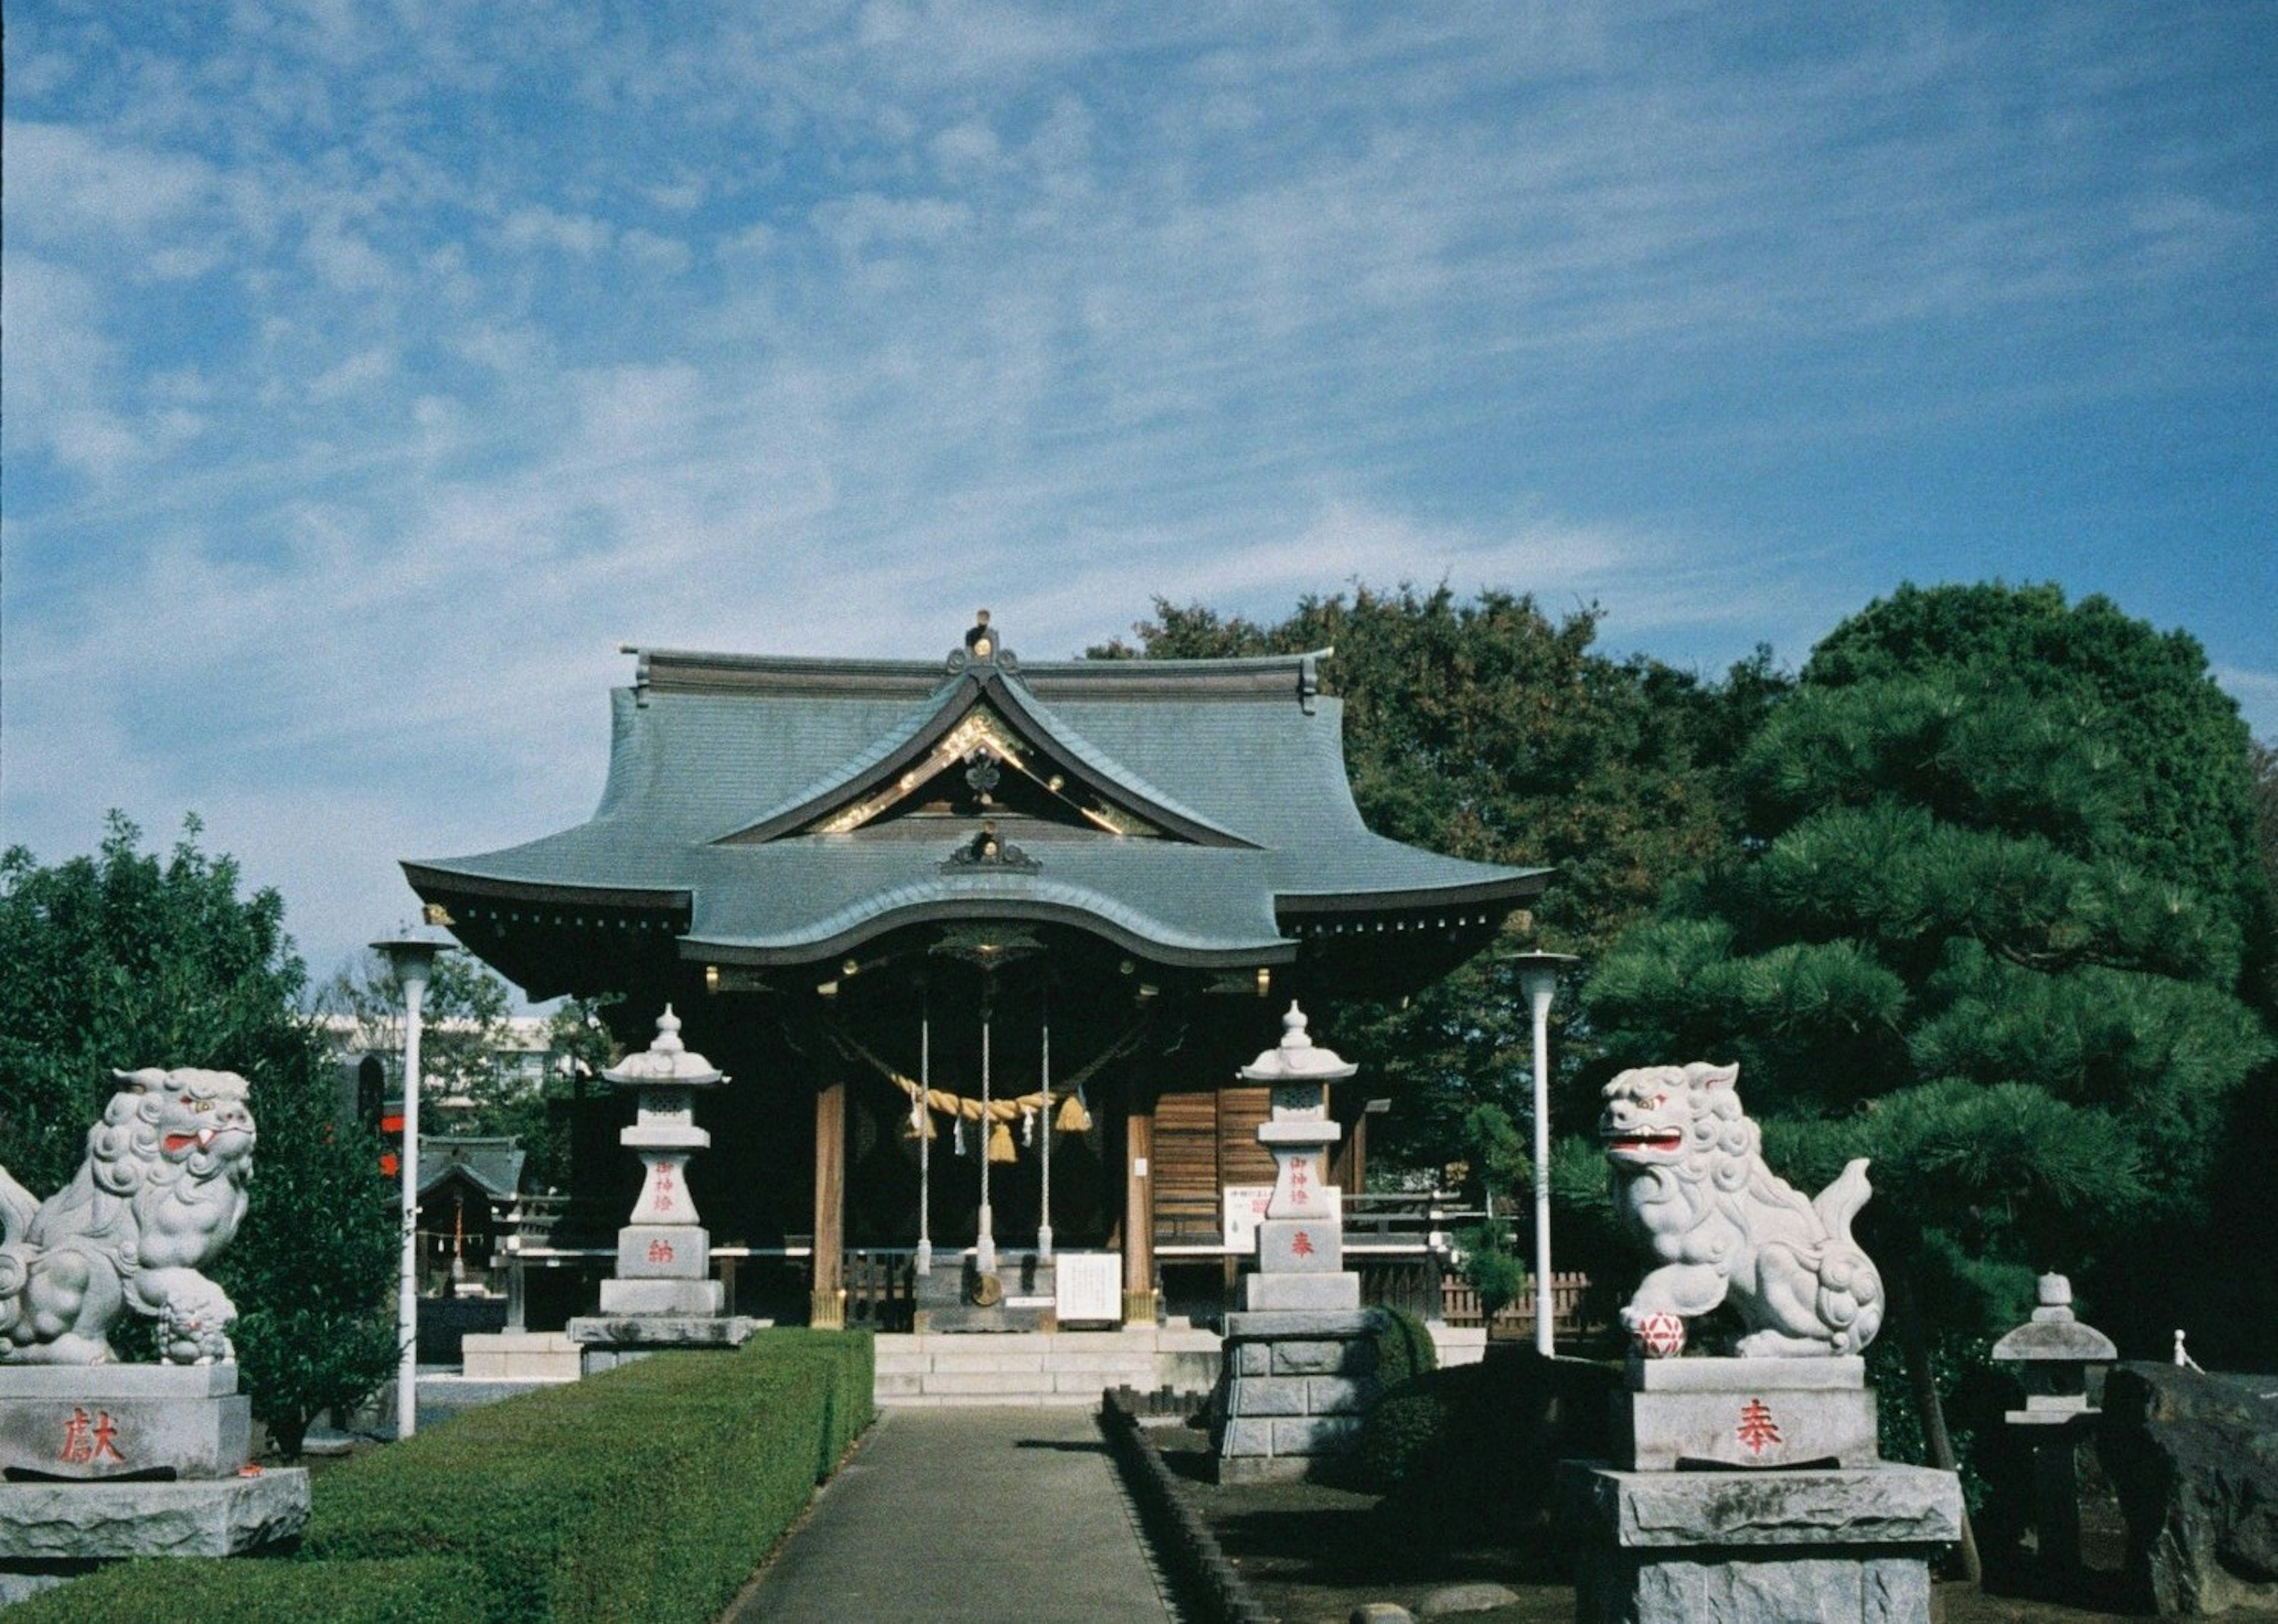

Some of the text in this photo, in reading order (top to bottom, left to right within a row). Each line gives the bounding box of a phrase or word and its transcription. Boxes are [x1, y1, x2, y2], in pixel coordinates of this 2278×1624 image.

[648, 1238, 674, 1263] 納
[1291, 1231, 1315, 1259] 奉
[1736, 1398, 1783, 1456] 奉
